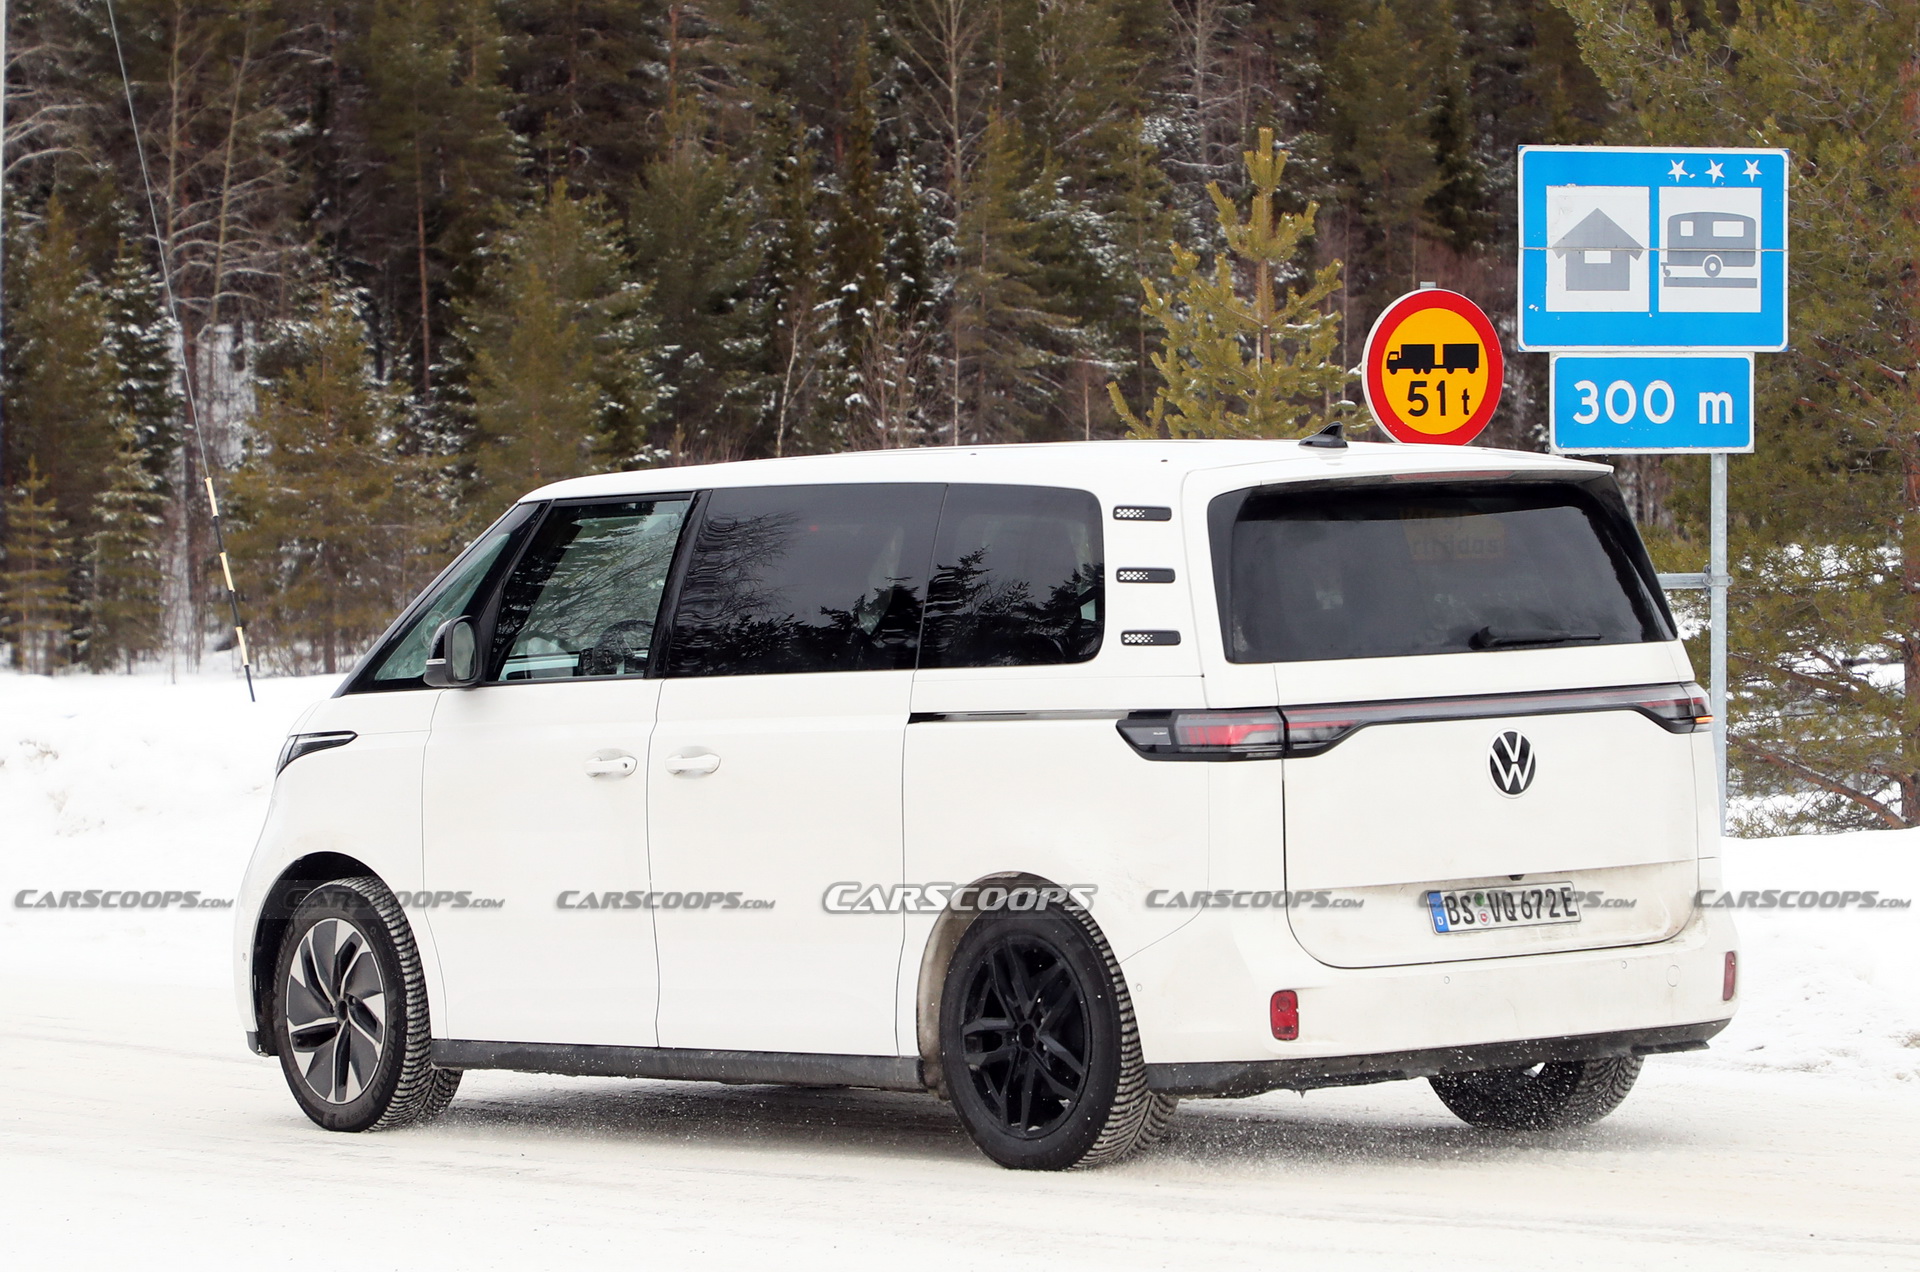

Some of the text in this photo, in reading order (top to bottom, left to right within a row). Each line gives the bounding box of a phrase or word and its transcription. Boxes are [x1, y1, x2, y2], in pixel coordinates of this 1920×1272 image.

[1408, 380, 1470, 417] 51 t
[1572, 379, 1733, 424] 300 m
[1489, 731, 1536, 795] VW
[1437, 916, 1444, 926] D
[1444, 895, 1475, 925] BS
